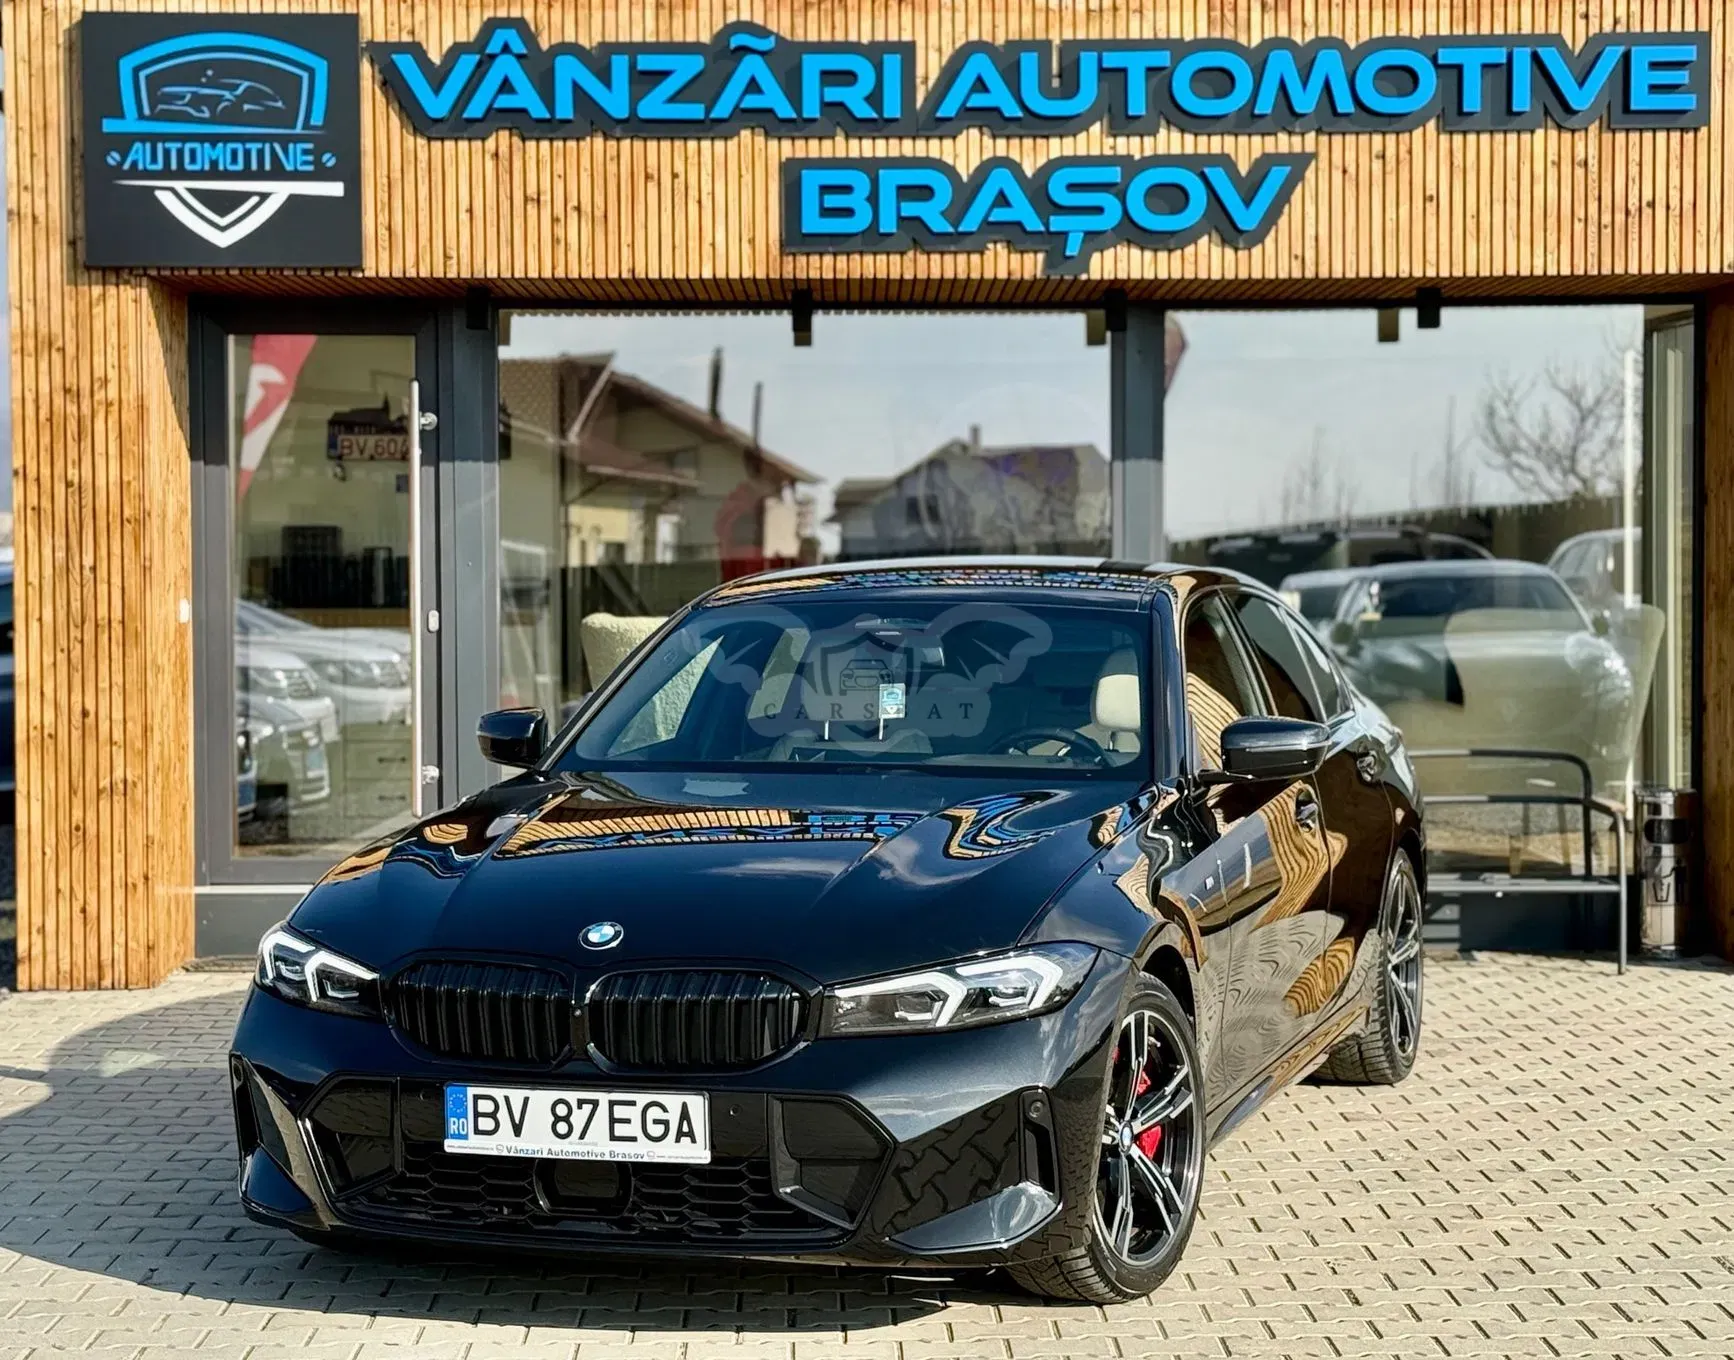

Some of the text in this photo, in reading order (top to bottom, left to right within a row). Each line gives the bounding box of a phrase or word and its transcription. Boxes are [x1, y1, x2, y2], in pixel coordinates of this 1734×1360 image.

[936, 44, 1698, 119] AUTOMOTIVE
[122, 142, 315, 171] AUTOMOTIVE
[450, 1117, 468, 1136] RO
[472, 1094, 530, 1138] BV
[546, 1148, 606, 1159] Automotive
